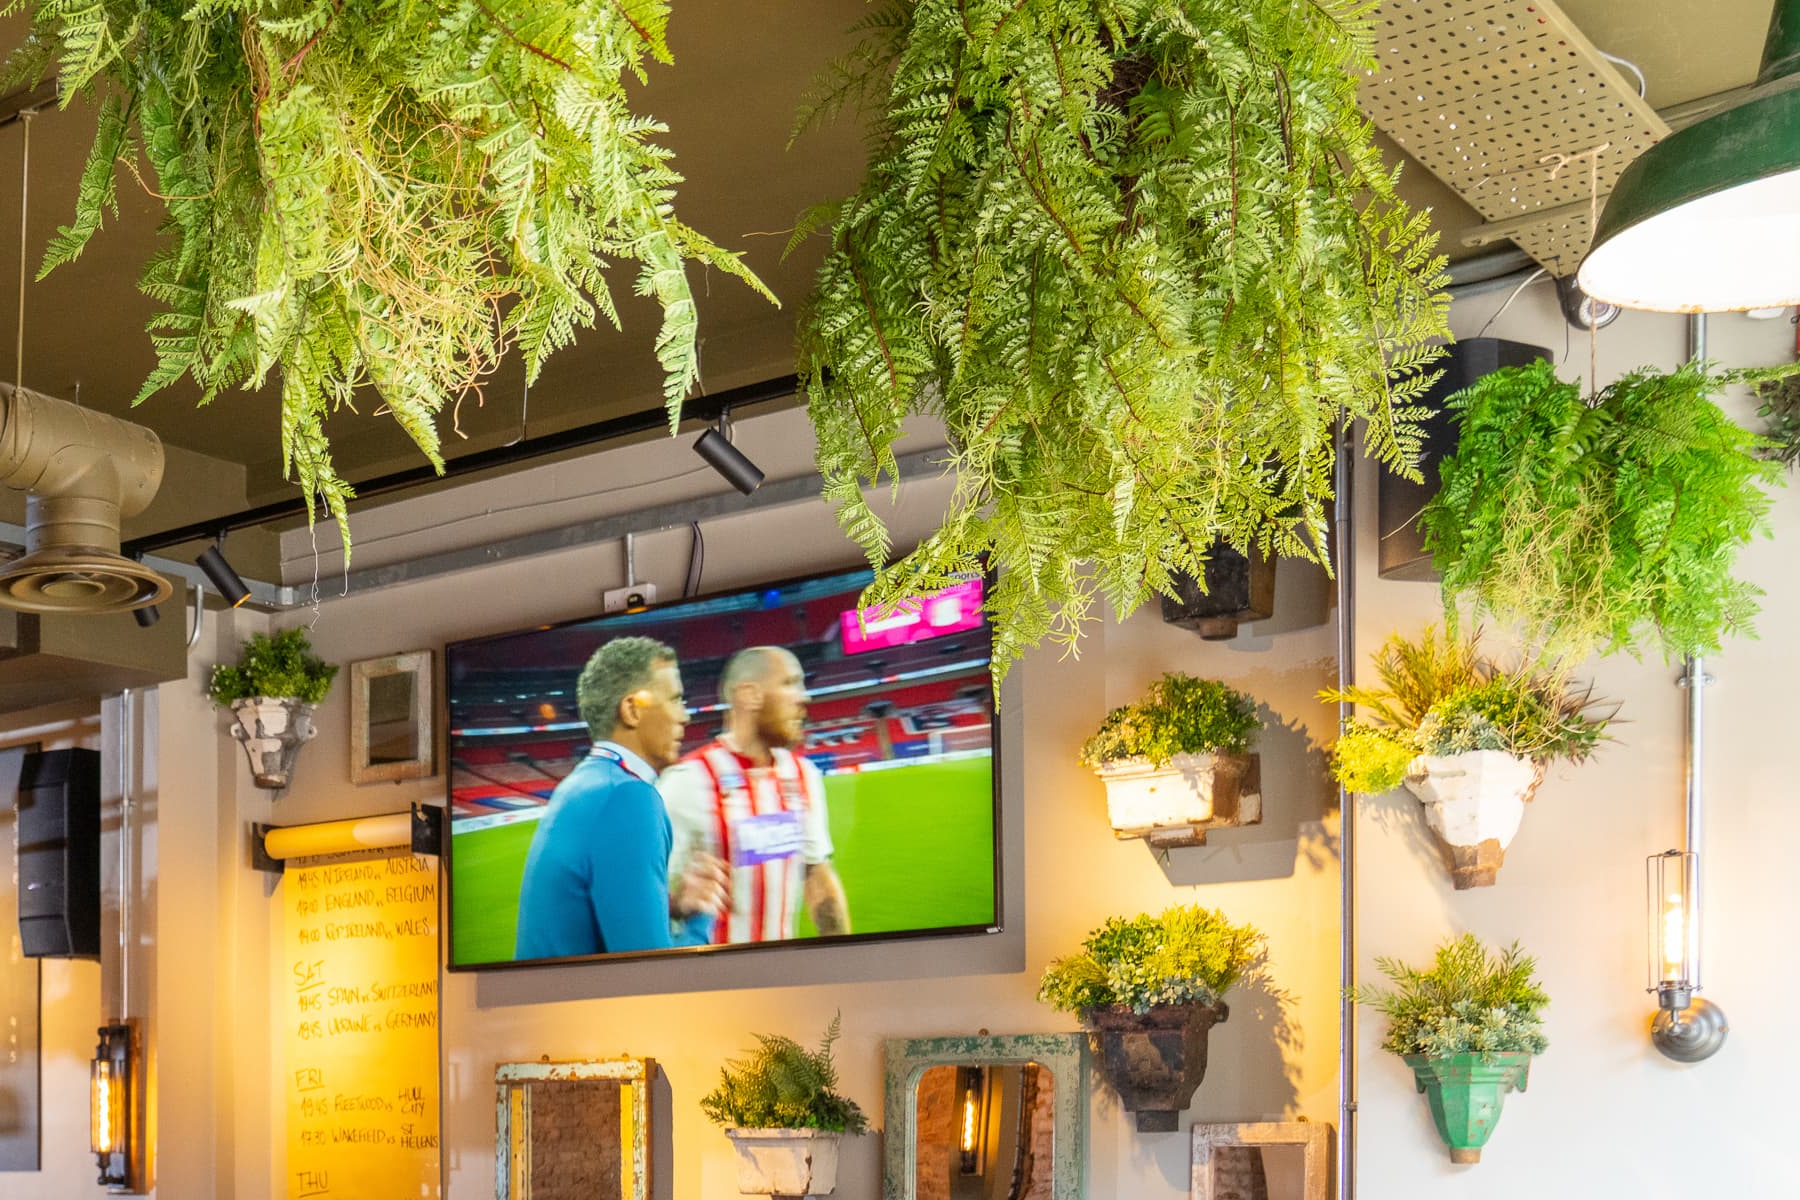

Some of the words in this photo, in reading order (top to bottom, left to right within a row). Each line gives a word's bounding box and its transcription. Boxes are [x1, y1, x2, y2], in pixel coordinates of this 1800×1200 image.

[385, 856, 430, 875] AUSTRIA
[325, 889, 375, 912] ENGLAND
[386, 883, 436, 904] BELGIUM
[395, 917, 431, 937] WALES
[293, 959, 325, 987] SAT
[371, 979, 438, 1003] SWITZERLAND
[385, 1008, 438, 1030] GERMANY
[295, 1067, 323, 1089] FRI
[334, 1093, 384, 1113] FLEETWOOD
[398, 1086, 425, 1101] HULL
[400, 1101, 425, 1118] CITY
[331, 1127, 386, 1145] WAKEFIELD
[400, 1134, 439, 1150] HELENS
[296, 1169, 328, 1191] THU
